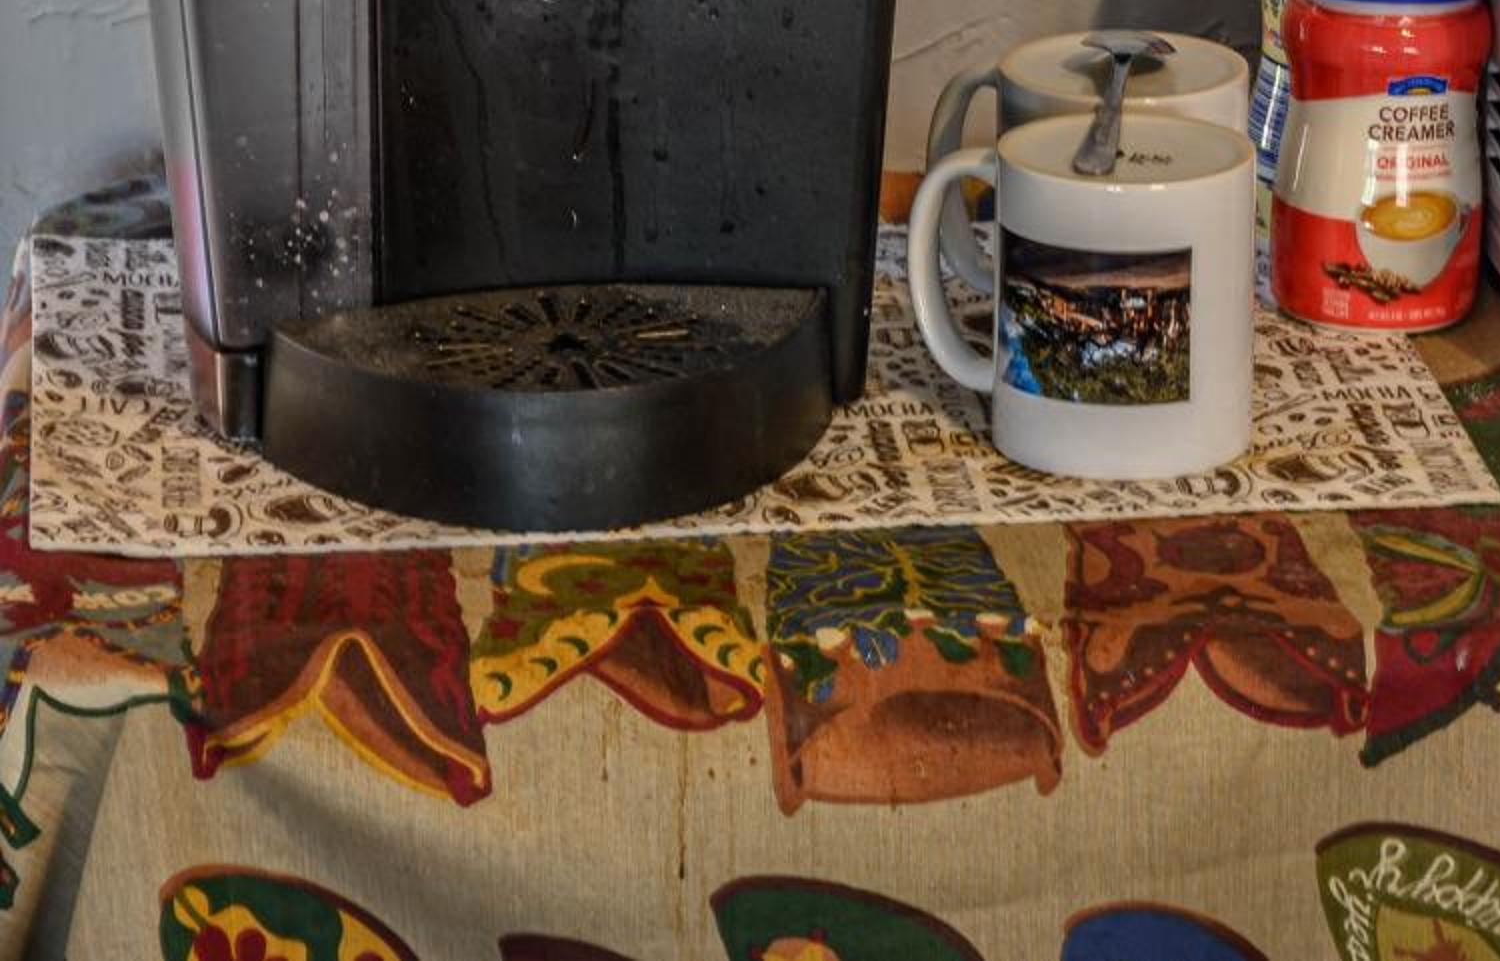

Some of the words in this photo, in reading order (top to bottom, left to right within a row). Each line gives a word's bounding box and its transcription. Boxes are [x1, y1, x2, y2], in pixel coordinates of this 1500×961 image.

[1379, 103, 1449, 123] COFFEE
[1367, 120, 1456, 141] CREAMER
[842, 401, 935, 419] MOCHA
